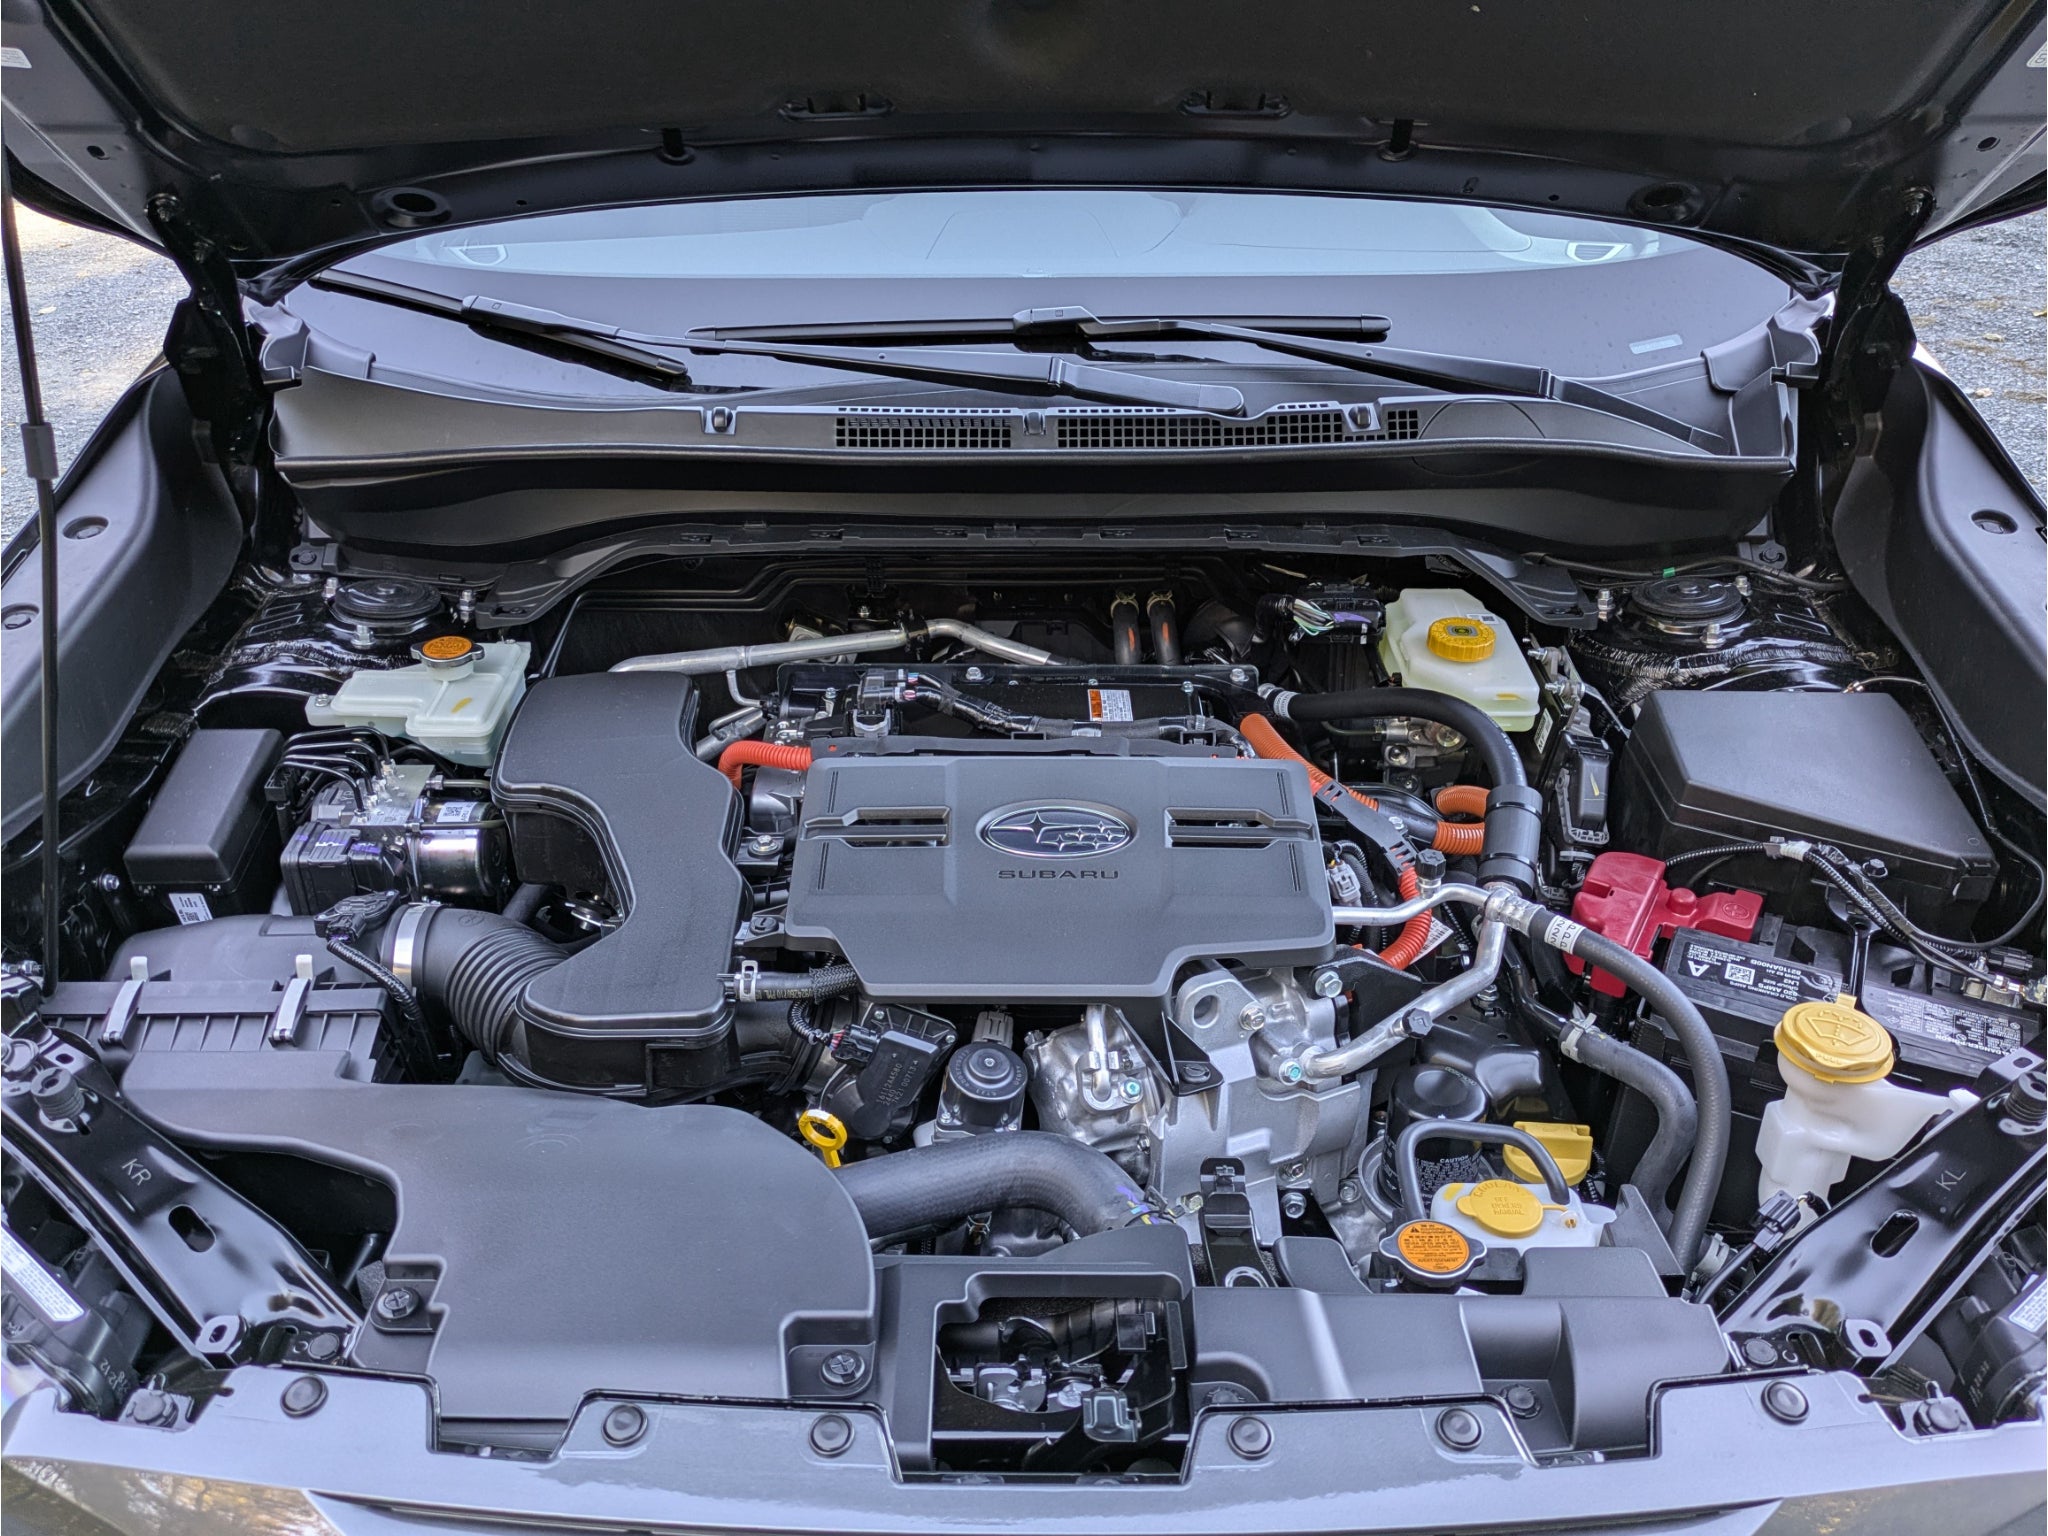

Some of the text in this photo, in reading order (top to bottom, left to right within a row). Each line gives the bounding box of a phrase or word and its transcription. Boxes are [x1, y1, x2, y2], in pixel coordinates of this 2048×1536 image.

[998, 870, 1119, 880] SUBARU
[1687, 961, 1711, 977] A
[1747, 985, 1780, 999] CRANKING
[1757, 982, 1781, 993] AMPS
[1780, 993, 1798, 1002] COLD
[1440, 1155, 1469, 1164] CAUTION
[122, 1158, 151, 1186] KR
[1935, 1170, 1967, 1191] KL
